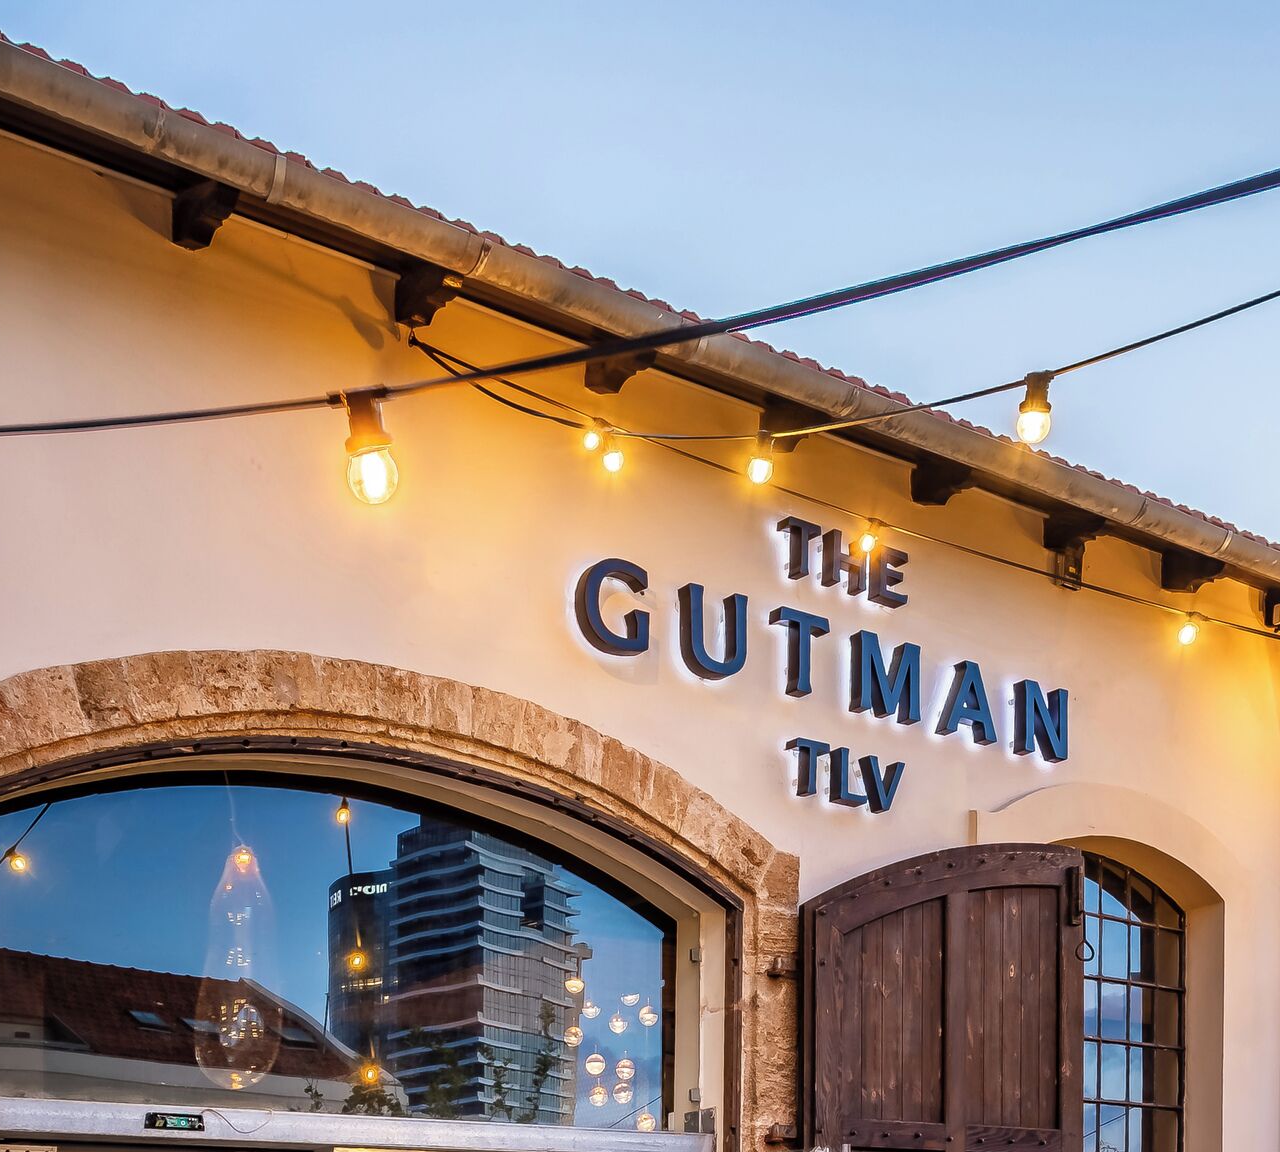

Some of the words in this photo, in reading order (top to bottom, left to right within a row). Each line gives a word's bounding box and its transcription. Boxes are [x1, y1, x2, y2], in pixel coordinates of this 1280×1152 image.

[777, 516, 909, 608] THE
[575, 557, 1069, 764] GUTMAN
[785, 736, 906, 814] TLV
